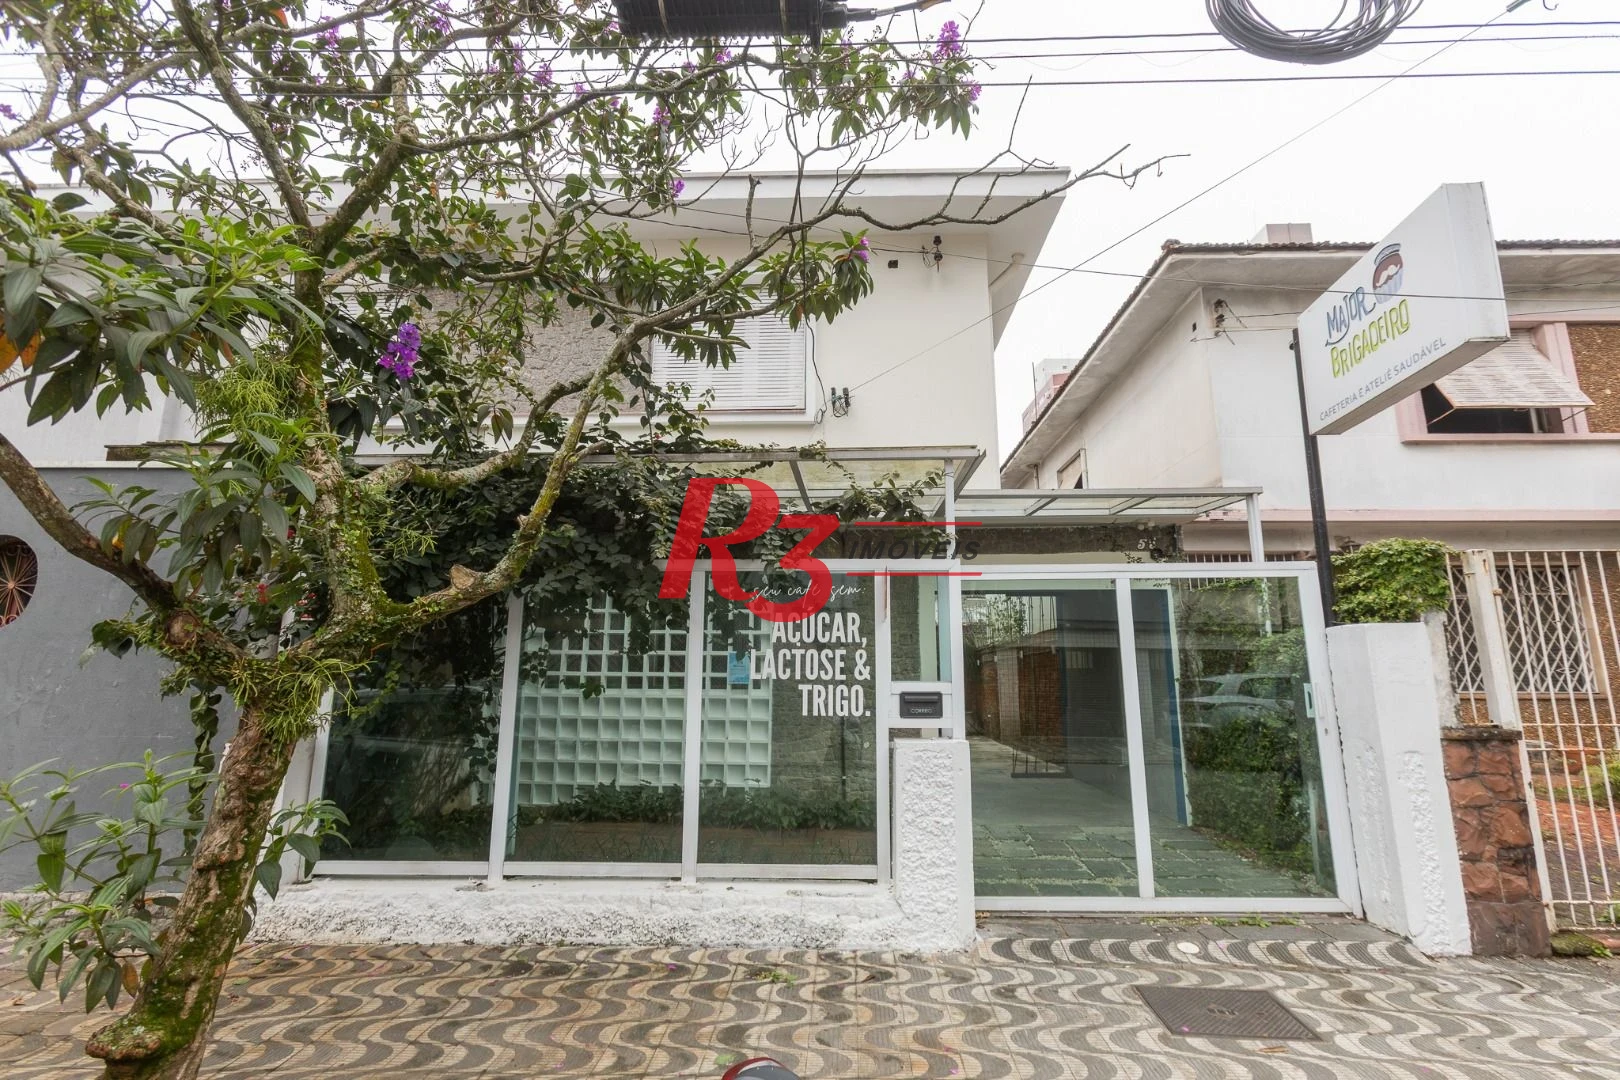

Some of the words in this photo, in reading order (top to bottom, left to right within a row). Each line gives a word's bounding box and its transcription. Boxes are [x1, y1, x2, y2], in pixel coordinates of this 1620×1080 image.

[1325, 286, 1377, 347] MAJOR
[1330, 299, 1411, 378] BRIGADEIRO
[1319, 393, 1358, 421] CAFETERIA
[1358, 388, 1366, 398] E
[1393, 337, 1447, 376] SAUDÁVEL
[750, 648, 847, 681] LACTOSE
[853, 649, 871, 681] &
[798, 685, 871, 717] TRIGO.
